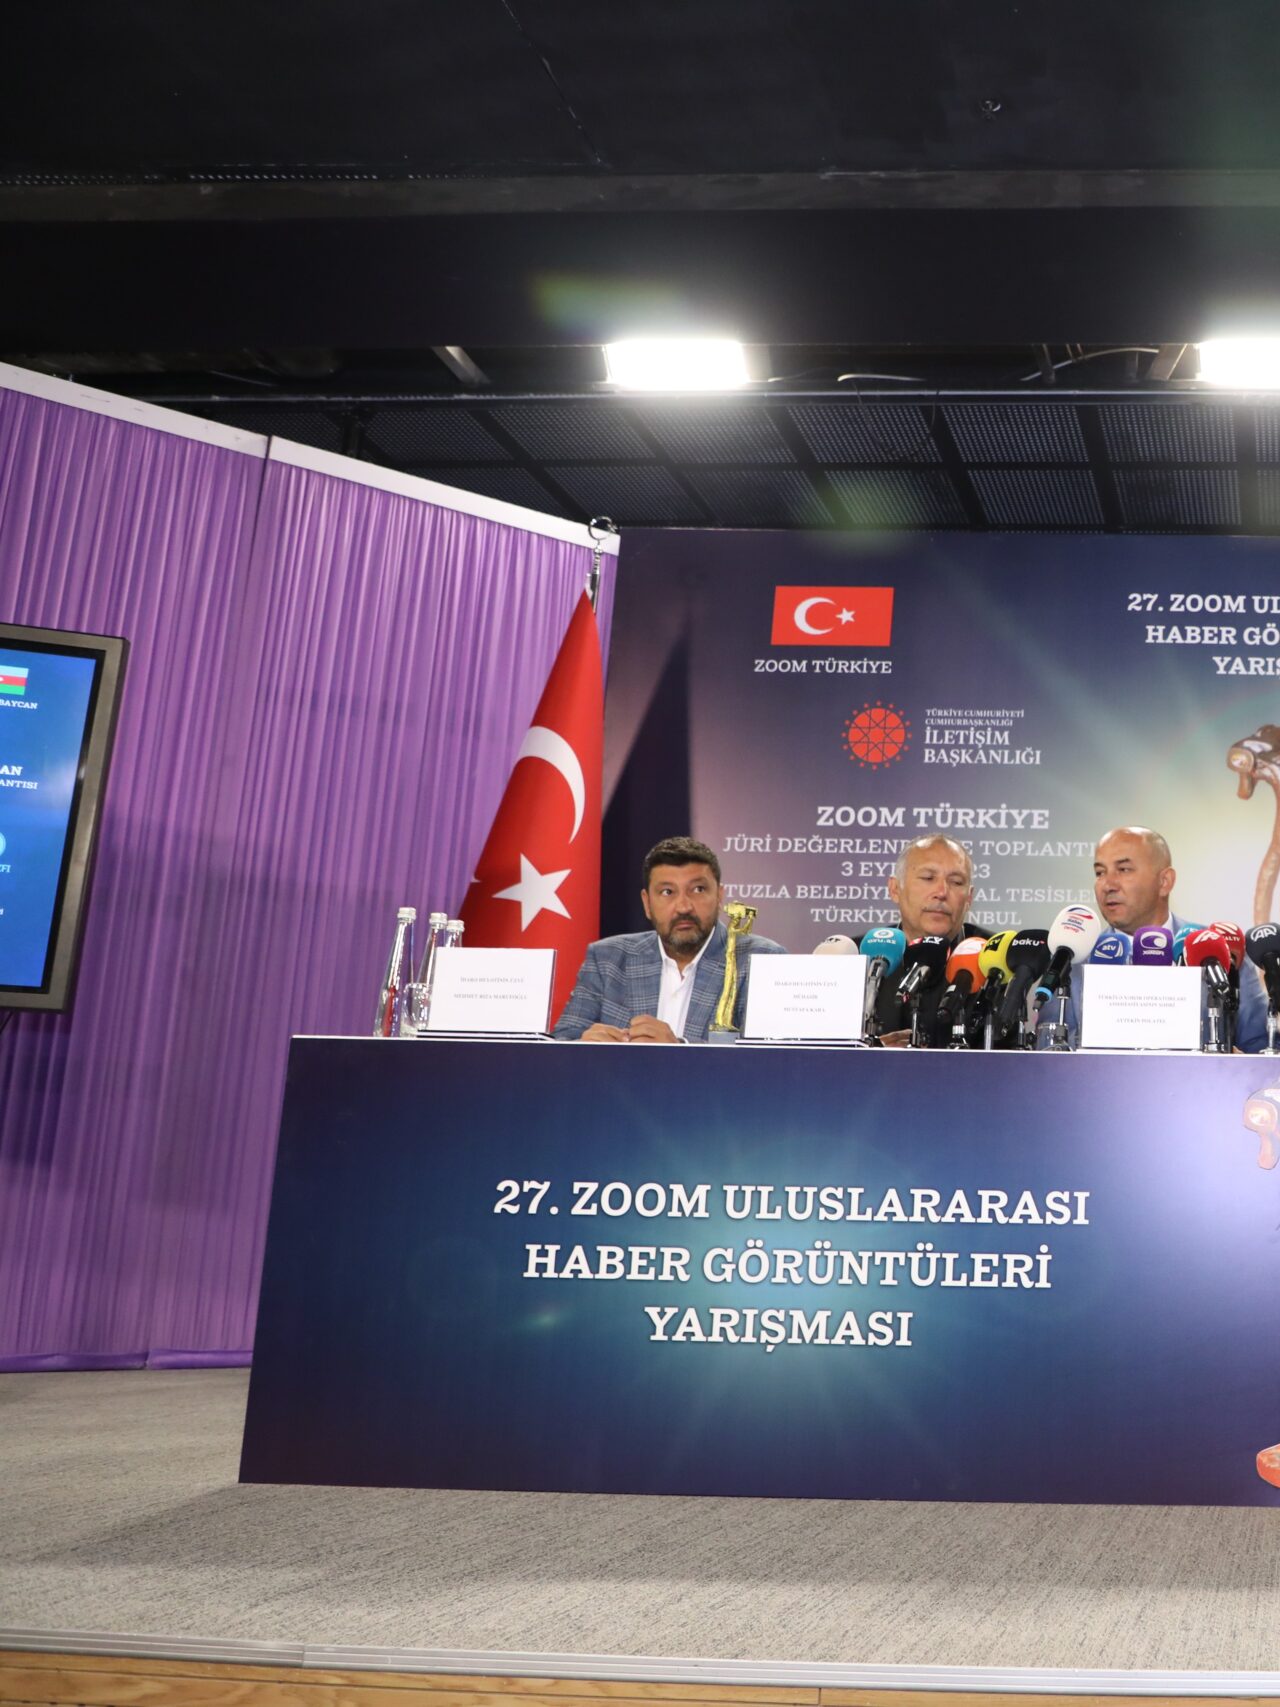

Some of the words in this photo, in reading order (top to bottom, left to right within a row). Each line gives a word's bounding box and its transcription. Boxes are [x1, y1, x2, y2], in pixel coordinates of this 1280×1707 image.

[1127, 593, 1164, 612] 27.
[1169, 594, 1246, 613] ZOOM
[1145, 625, 1237, 645] HABER
[754, 660, 807, 674] ZOOM
[812, 657, 892, 674] TÜRKİYE
[925, 708, 963, 717] TÜRKİYE
[964, 709, 1025, 718] CUMHURİYETİ
[925, 718, 1013, 727] CUMHURBAŞKANLIĞI
[924, 726, 1010, 748] İLETİŞİM
[923, 747, 1041, 767] BAŞKANLIĞI
[0, 779, 38, 790] ANTISI
[817, 806, 904, 828] ZOOM
[913, 803, 1050, 830] TÜRKİYE
[723, 833, 773, 853] JÜRİ
[841, 862, 854, 877] 3
[723, 884, 791, 899] TUZLA
[811, 906, 900, 924] TÜRKİYE
[1012, 938, 1040, 947] baku
[492, 1180, 558, 1215] 27.
[571, 1182, 710, 1218] ZOOM
[723, 1185, 1090, 1225] ULUSLARARASI
[523, 1244, 690, 1282] HABER
[702, 1239, 1052, 1289] GÖRÜNTÜLERİ
[645, 1307, 913, 1353] YARIŞMASI
